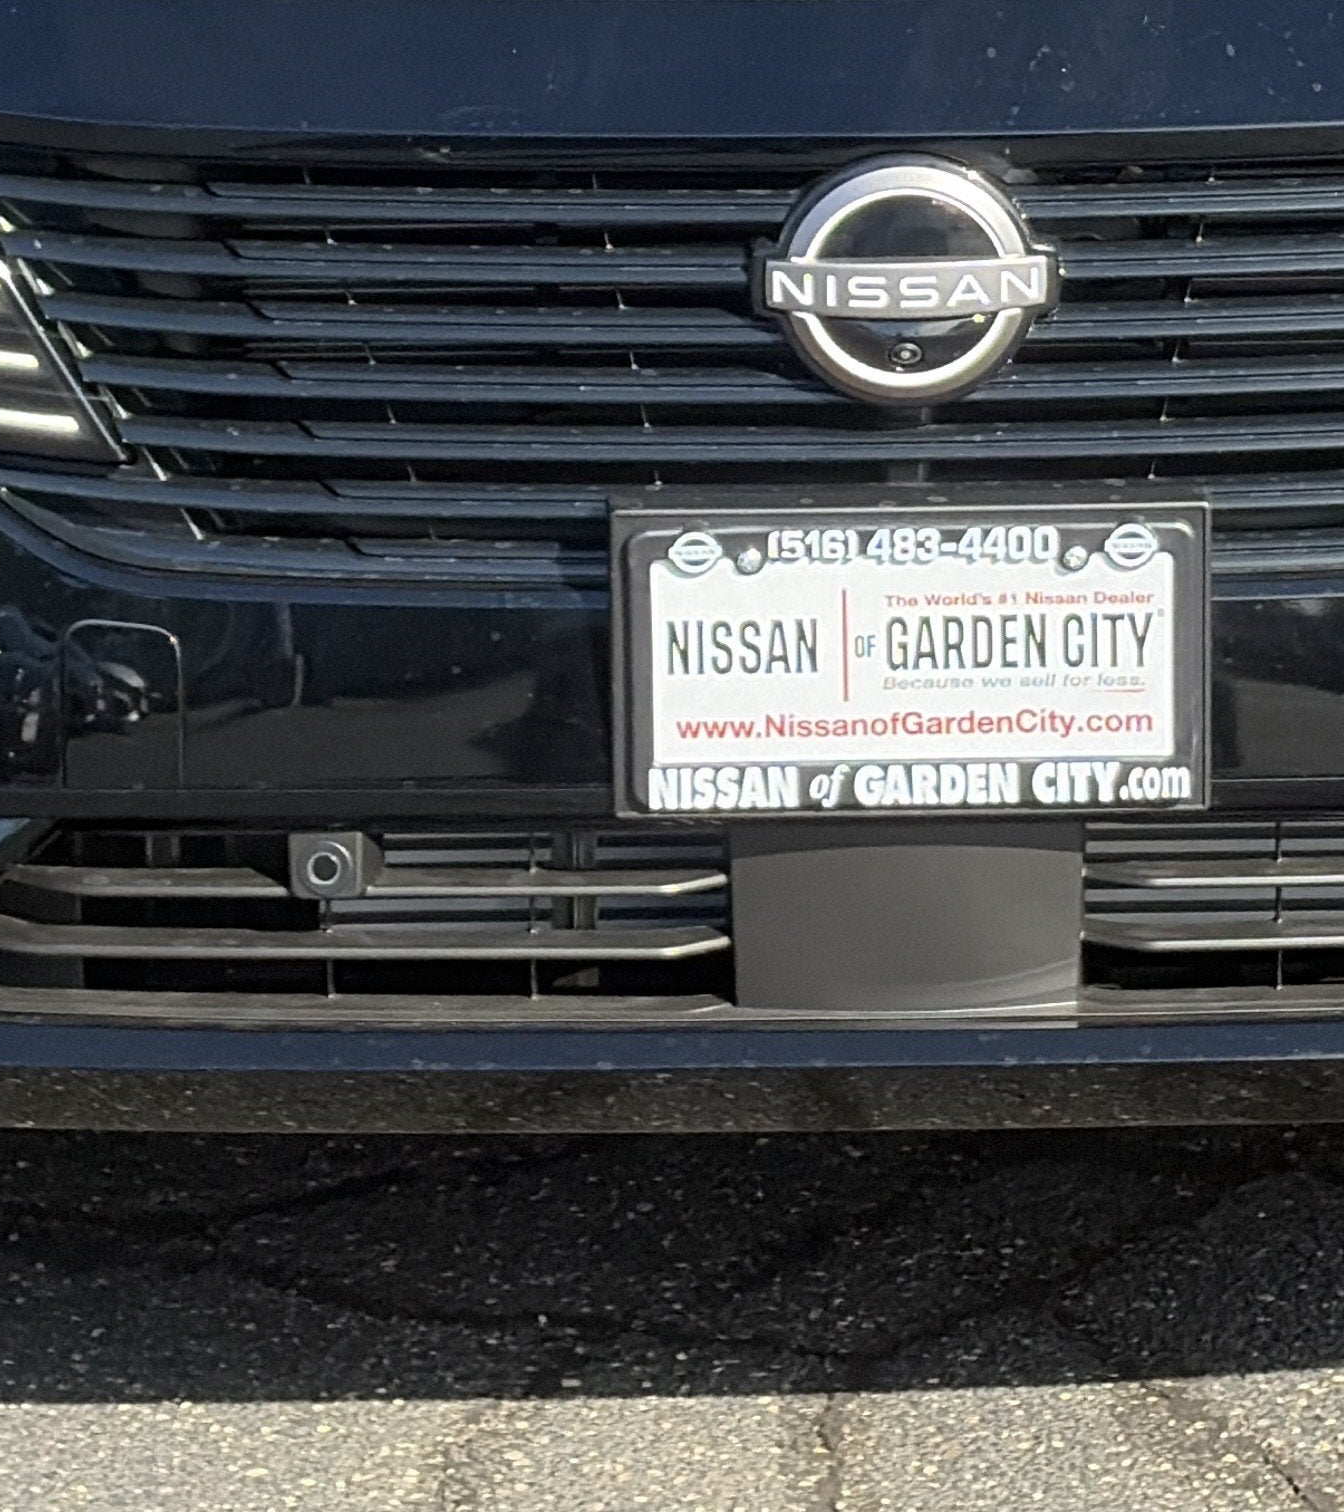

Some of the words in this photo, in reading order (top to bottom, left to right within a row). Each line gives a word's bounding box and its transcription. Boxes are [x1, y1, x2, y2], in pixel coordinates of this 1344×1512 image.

[771, 267, 1041, 309] NISSAN
[767, 529, 858, 560] (516)
[865, 525, 1060, 562] 483-4400
[884, 593, 919, 608] The
[923, 592, 993, 606] World's
[1024, 590, 1089, 605] Nissan
[1093, 590, 1155, 605] Dealer
[665, 617, 820, 676] NISSAN
[854, 634, 877, 659] OF
[886, 612, 1048, 672] GARDEN
[1063, 611, 1154, 668] CITY
[882, 674, 975, 690] Because
[981, 675, 1013, 689] we
[1019, 672, 1057, 688] sell
[1062, 672, 1092, 687] for
[675, 708, 1154, 740] www.NissanofGardenCity.com
[648, 764, 800, 810] NISSAN
[808, 763, 851, 809] of
[853, 761, 1021, 808] GARDEN
[1031, 760, 1192, 805] CITY.com
